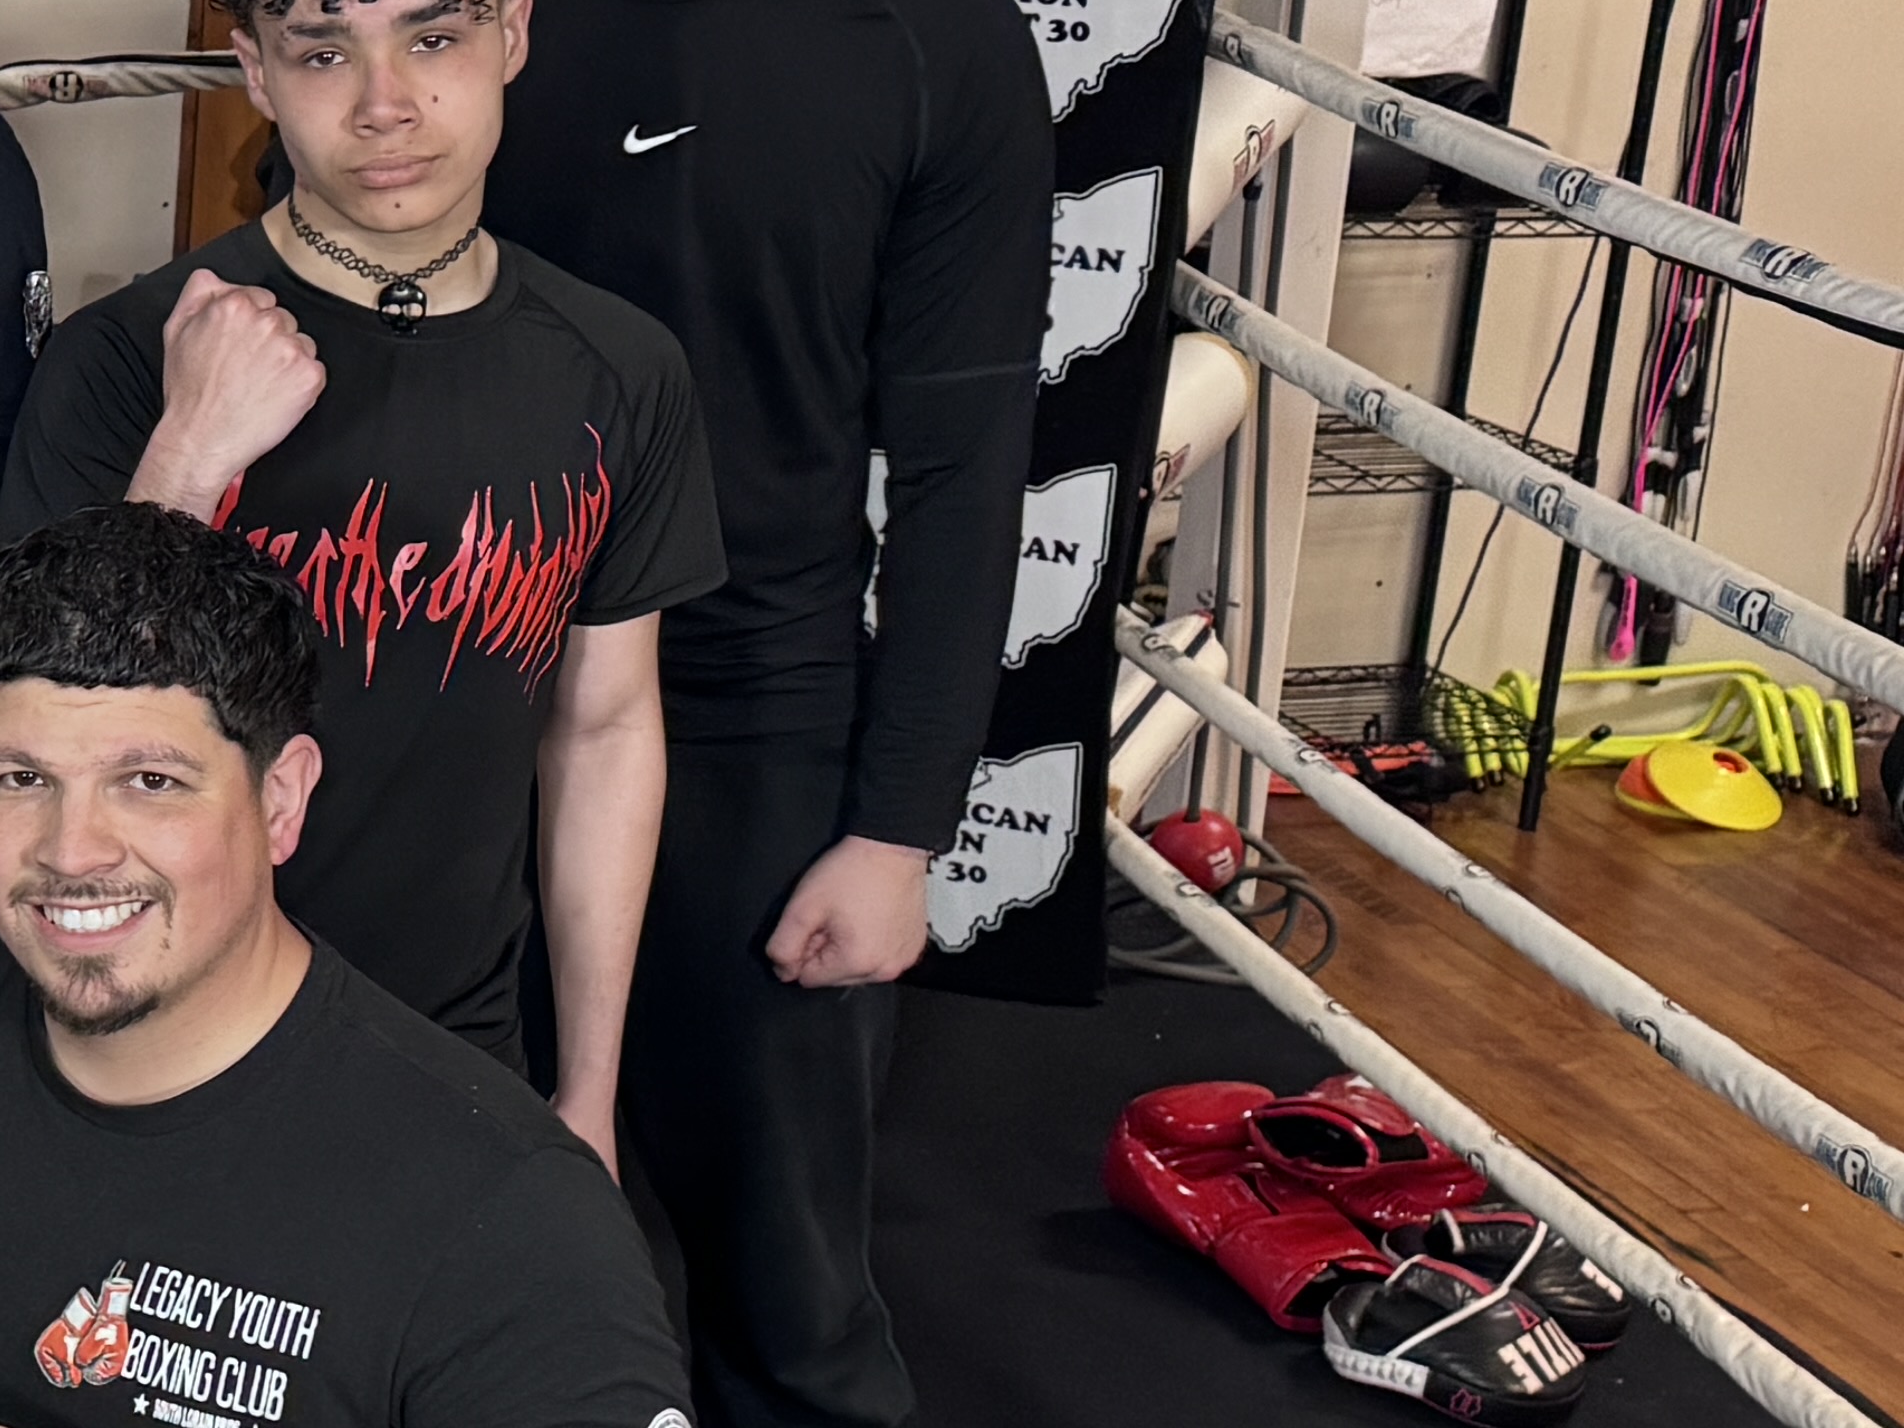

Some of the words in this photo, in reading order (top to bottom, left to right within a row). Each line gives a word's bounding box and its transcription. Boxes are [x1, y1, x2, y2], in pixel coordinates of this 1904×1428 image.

[1046, 20, 1091, 43] 30
[945, 861, 987, 883] 30
[129, 1261, 232, 1332] LEGACY
[227, 1288, 321, 1360] YOUTH
[120, 1328, 216, 1403] BOXING
[215, 1357, 288, 1421] CLUB
